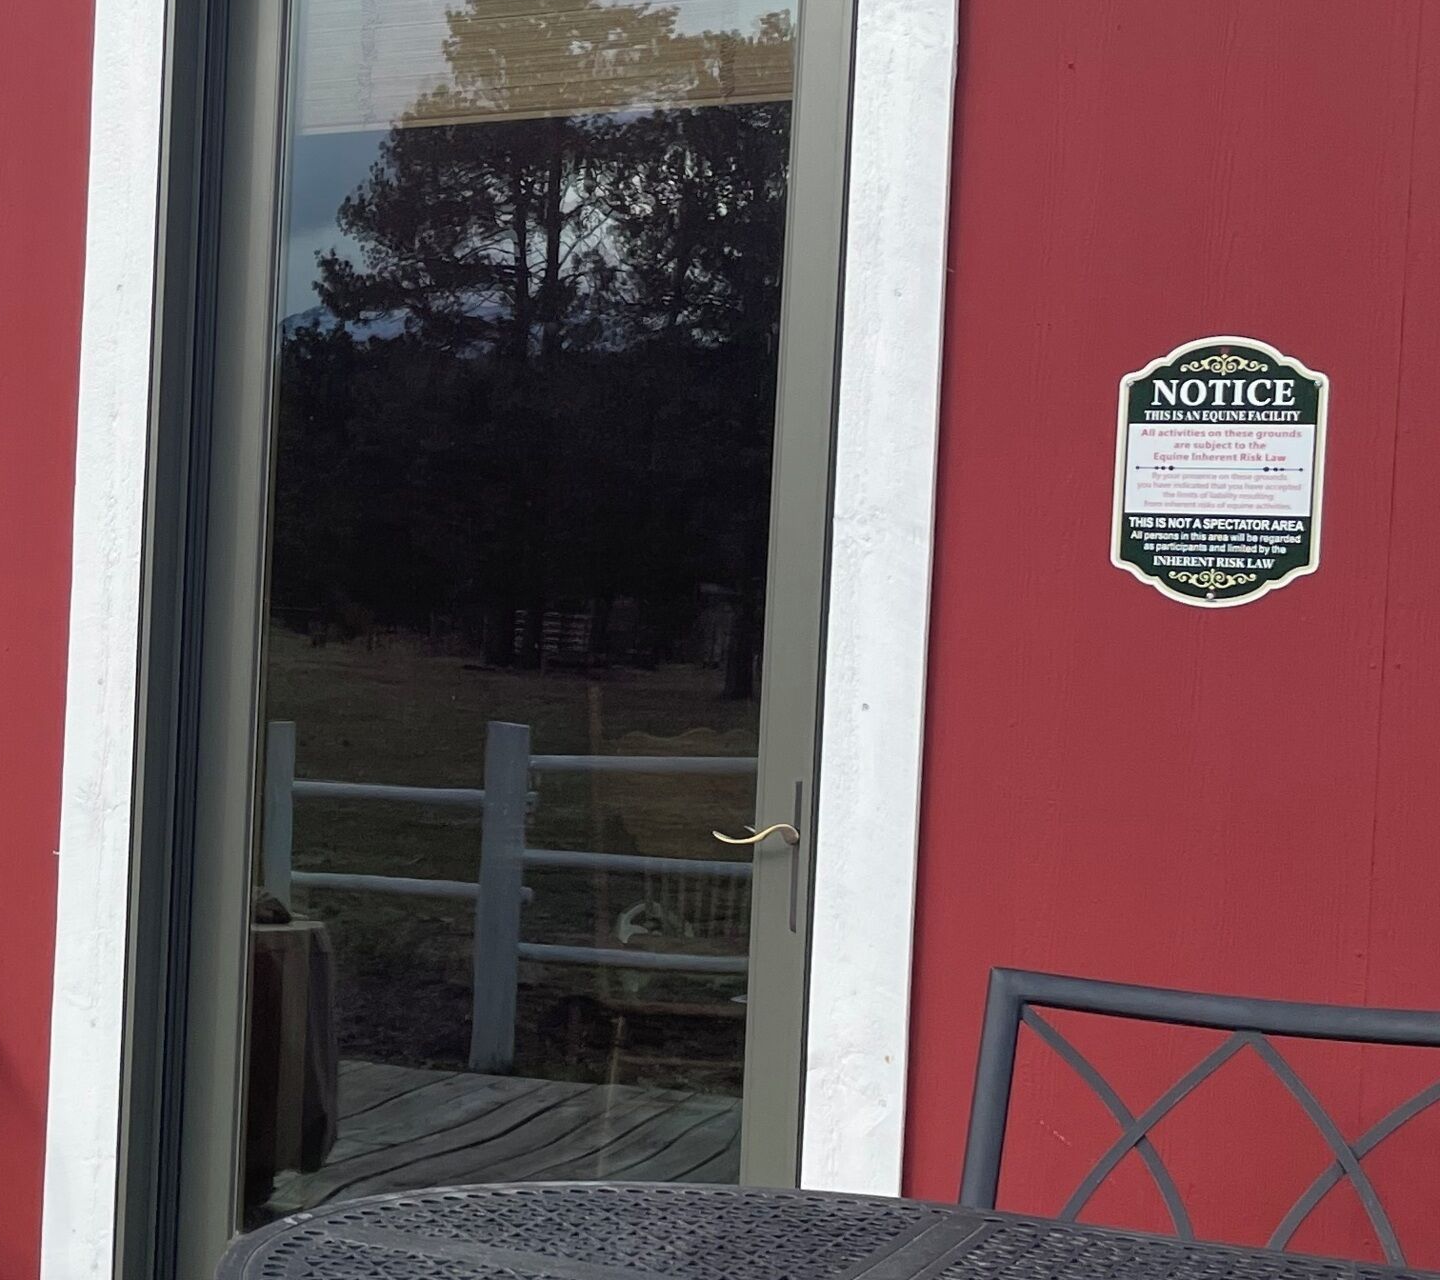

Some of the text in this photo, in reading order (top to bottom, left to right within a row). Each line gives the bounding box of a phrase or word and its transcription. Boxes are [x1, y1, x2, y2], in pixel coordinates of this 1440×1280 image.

[1151, 378, 1296, 407] NOTICE
[1144, 410, 1301, 423] THIS IS AN EQUINE FACILITY
[1141, 429, 1156, 437] All
[1158, 429, 1206, 437] activities
[1224, 429, 1253, 438] these
[1255, 430, 1302, 440] grounds
[1193, 441, 1232, 451] subject
[1249, 441, 1266, 449] the
[1153, 452, 1286, 462] Equine Inherent Risk Law
[1129, 516, 1304, 531] THIS IS NOT A SPECTATOR AREA
[1130, 530, 1143, 539] All
[1144, 532, 1179, 541] persons
[1181, 531, 1189, 539] in
[1190, 531, 1207, 540] this
[1230, 532, 1245, 541] will
[1246, 533, 1258, 542] be
[1260, 534, 1301, 545] regarded
[1143, 542, 1287, 556] as participants and limited by the
[1153, 555, 1275, 569] INHERENT RISK LAW
